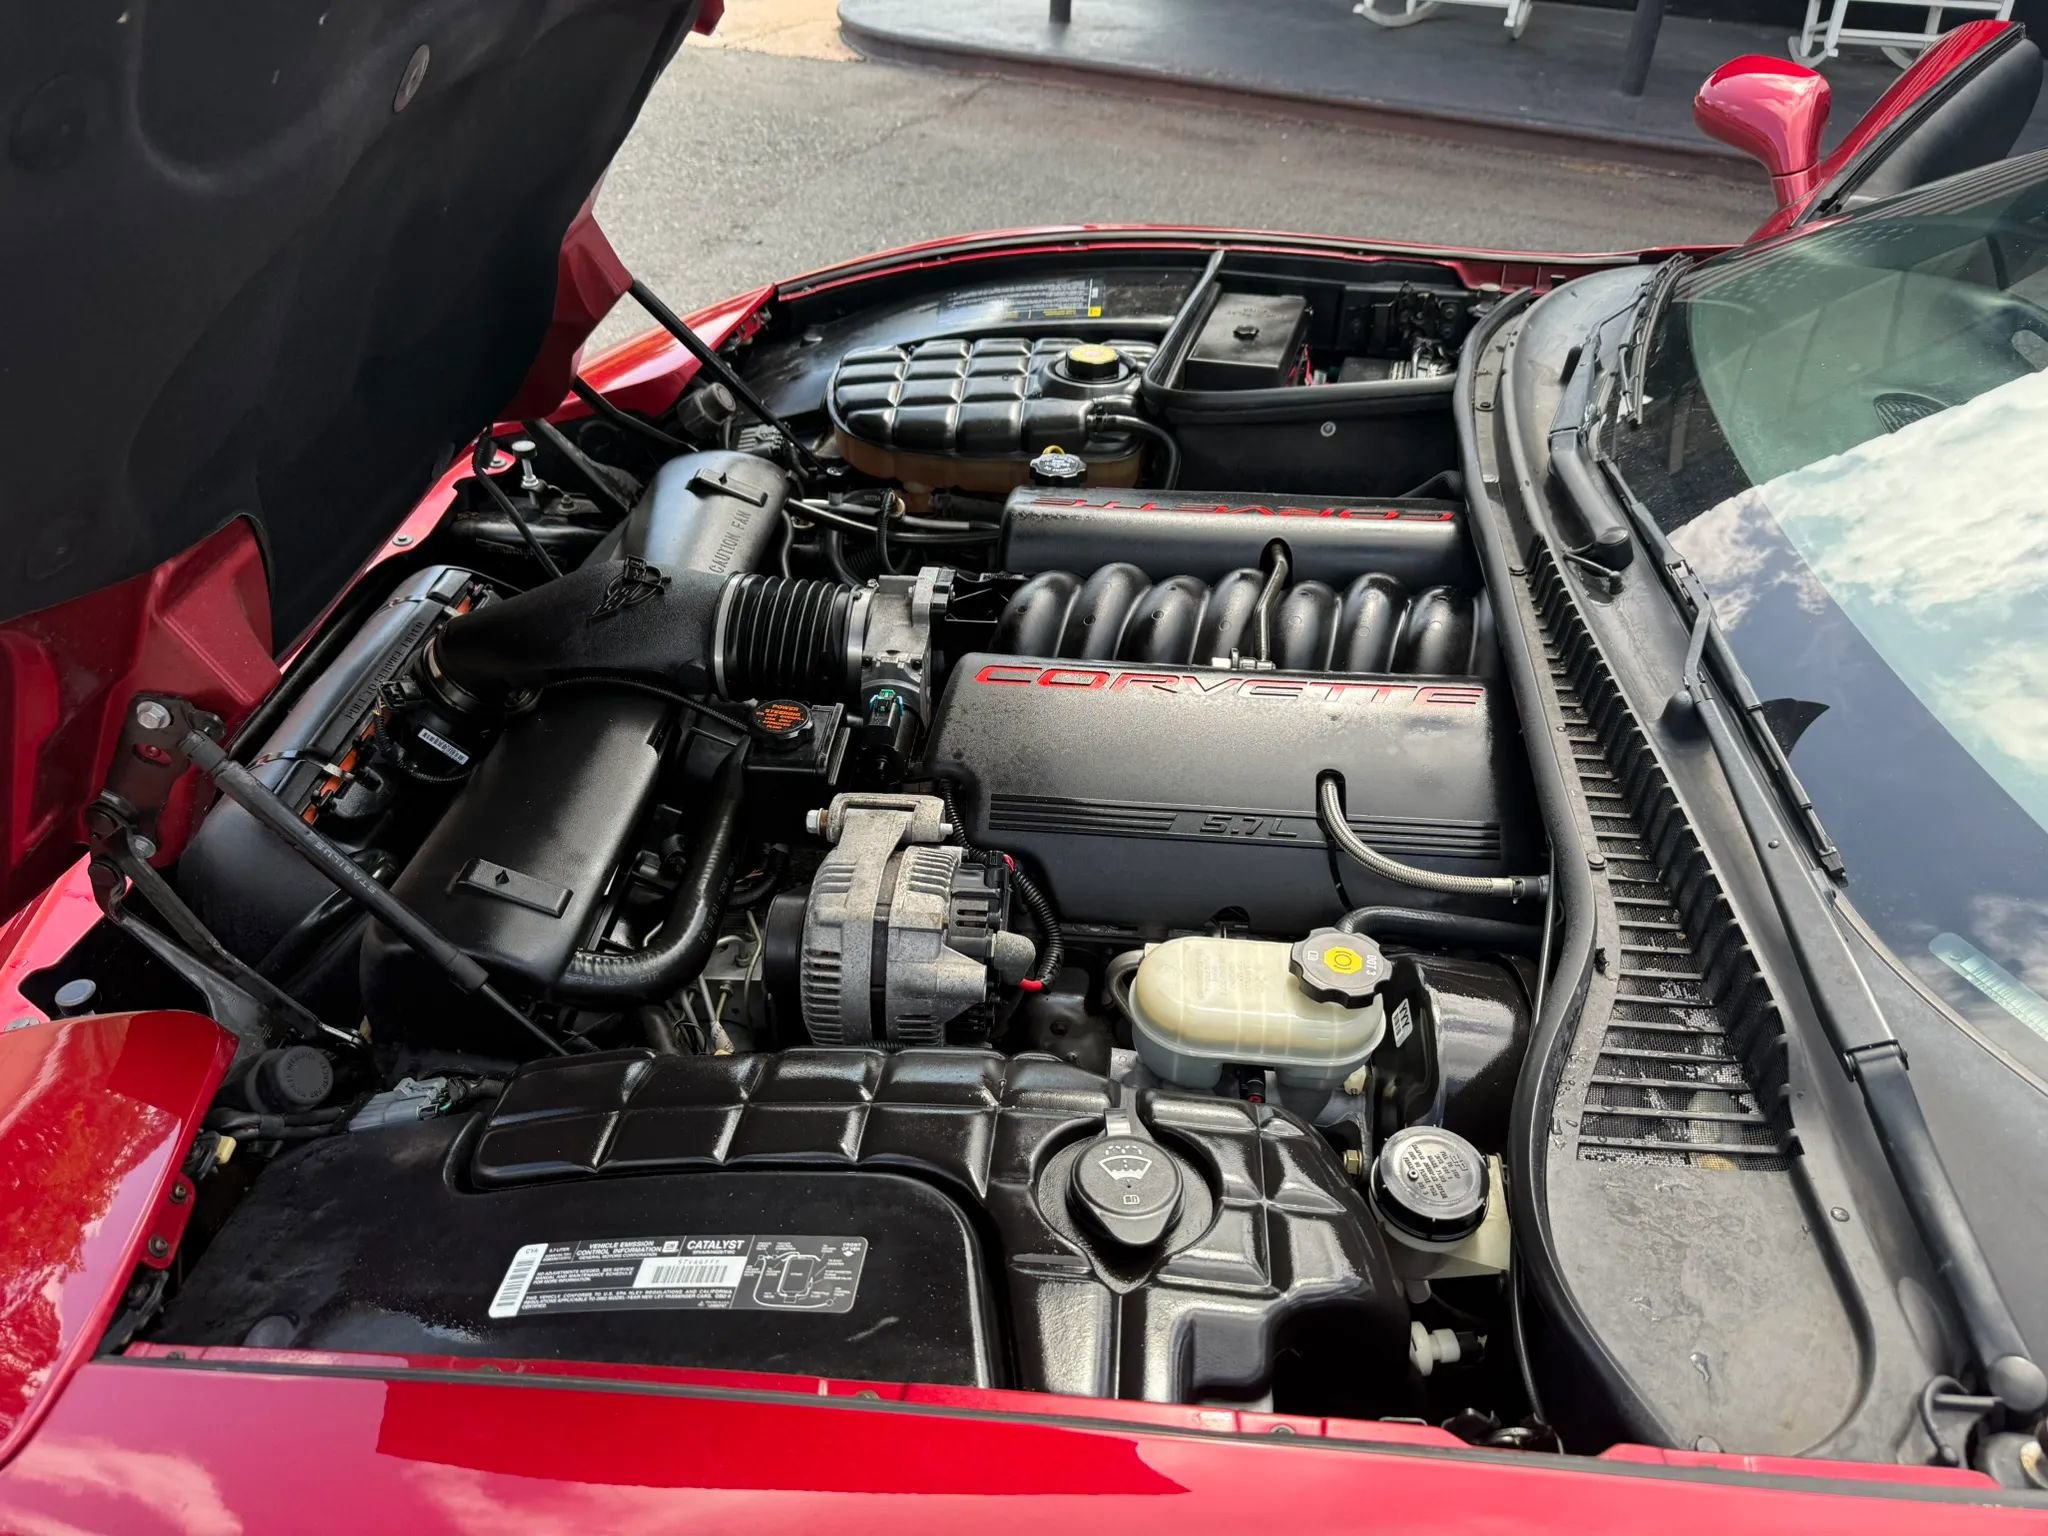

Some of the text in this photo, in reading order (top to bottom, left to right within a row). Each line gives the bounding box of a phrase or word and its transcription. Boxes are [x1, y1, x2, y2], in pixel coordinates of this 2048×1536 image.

[708, 510, 752, 574] CAUTION FAN
[973, 664, 1485, 707] CORVETTE
[765, 708, 800, 716] STEERING
[1199, 813, 1299, 838] 5.7L
[313, 842, 377, 895] STABILUS
[1366, 954, 1377, 977] DOT 3
[612, 1246, 662, 1254] INFORMATION
[620, 1240, 654, 1248] EMISSION
[687, 1240, 746, 1250] CATALYST
